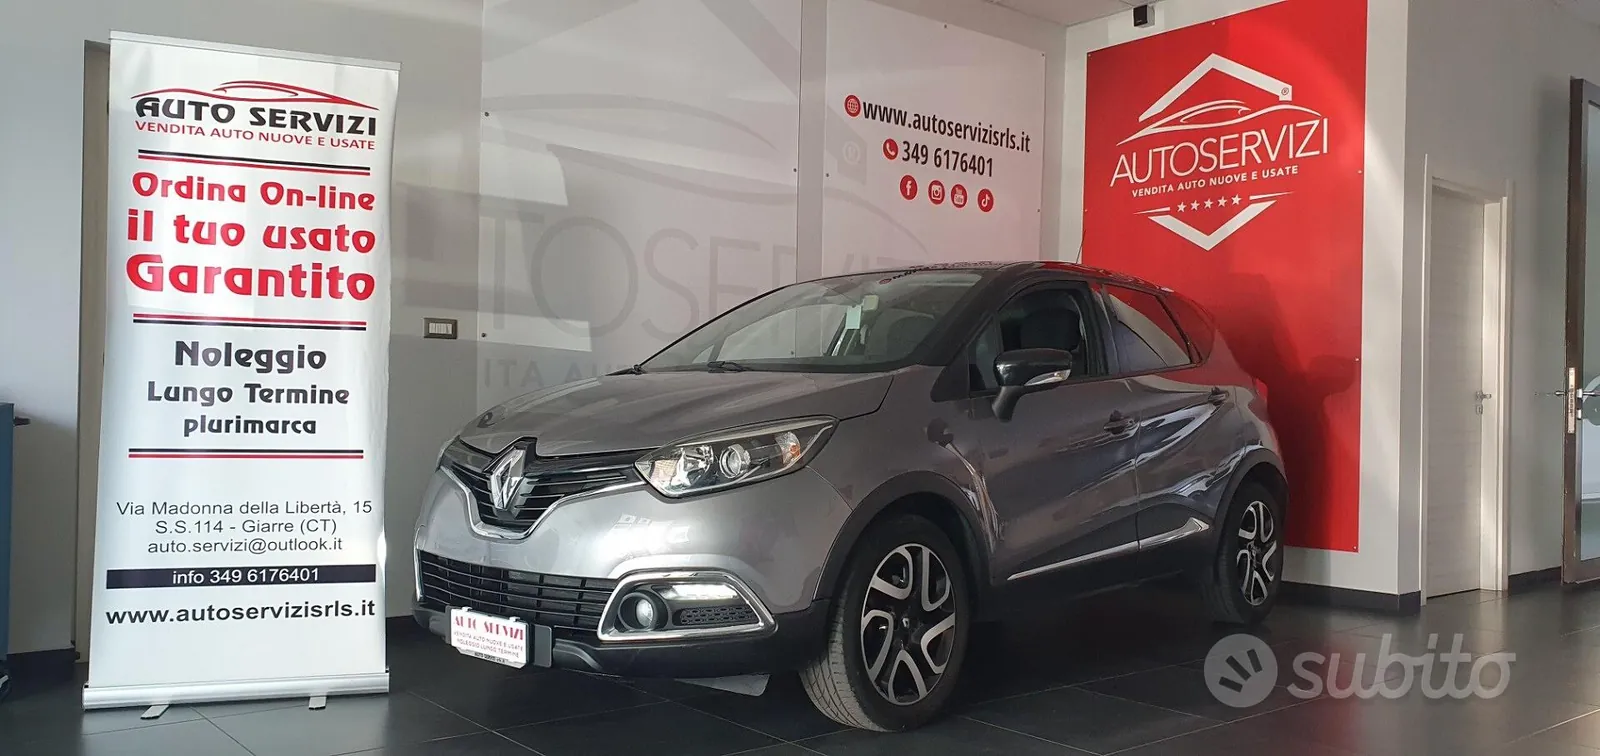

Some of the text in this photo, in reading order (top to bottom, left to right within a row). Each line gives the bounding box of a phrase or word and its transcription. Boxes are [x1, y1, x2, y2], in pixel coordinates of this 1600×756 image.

[135, 97, 376, 136] AUTO SERVIZI
[863, 101, 1031, 153] www.autoservizisrls.it
[135, 120, 375, 150] VENDITA AUTO NUOVE E USATE
[902, 140, 993, 177] 349 6176401
[1110, 118, 1328, 187] AUTOSERVIZI
[132, 171, 375, 211] Ordina On-line
[1131, 165, 1299, 198] VENDITA AUTO NUOVE E USATE
[128, 208, 376, 254] il tuo usato
[126, 254, 375, 301] Garantito
[175, 340, 327, 374] Noleggio
[148, 381, 350, 407] Lungo Termine
[183, 415, 316, 437] plurimarca
[116, 500, 373, 516] Via Madonna della Libertà, 15
[155, 520, 224, 534] S.S.114
[242, 519, 294, 533] Giarre
[300, 518, 337, 535] (CT)
[148, 537, 343, 555] auto.servizi@outlook.it
[172, 568, 319, 585] info 349 6176401
[106, 599, 376, 625] www.autoservizisrls.it
